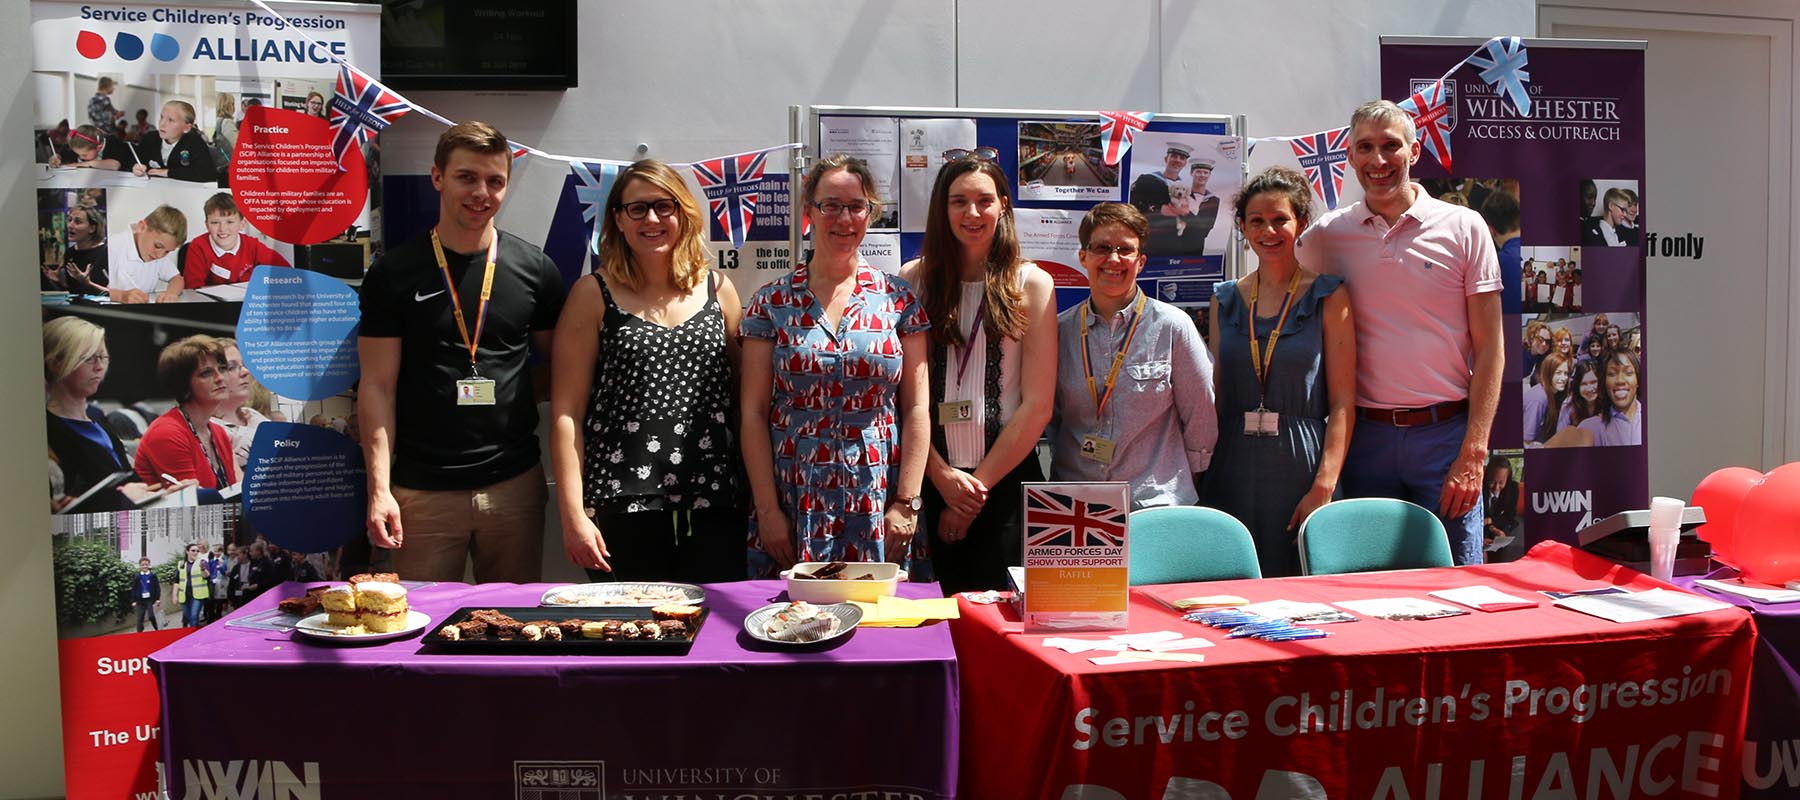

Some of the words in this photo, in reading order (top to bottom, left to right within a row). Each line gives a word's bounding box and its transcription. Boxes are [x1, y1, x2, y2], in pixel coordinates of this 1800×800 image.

[81, 6, 147, 22] Service
[153, 8, 240, 25] Children's
[246, 12, 345, 30] Progression
[192, 37, 346, 63] ALLIANCE
[1530, 86, 1543, 95] OF
[1466, 99, 1619, 120] WINHESTER
[254, 125, 288, 134] Practice
[1468, 126, 1521, 139] ACCESS
[1524, 127, 1536, 139] &
[1539, 127, 1620, 140] OUTREACH
[734, 184, 758, 193] HEROES
[757, 193, 772, 202] the
[756, 205, 772, 214] the
[756, 216, 782, 226] wells
[756, 248, 771, 257] the
[1662, 233, 1704, 259] only
[719, 250, 739, 269] L3
[756, 261, 768, 269] su
[274, 440, 300, 449] Policy
[1532, 490, 1592, 514] UWIN
[1060, 570, 1092, 579] RAFFLE
[97, 657, 151, 676] Supp
[1072, 700, 1250, 750] Service
[1265, 684, 1490, 736] Children's
[1504, 665, 1732, 724] Progression
[89, 730, 129, 747] The
[623, 767, 748, 785] UNIVERSITY
[754, 769, 782, 784] OF
